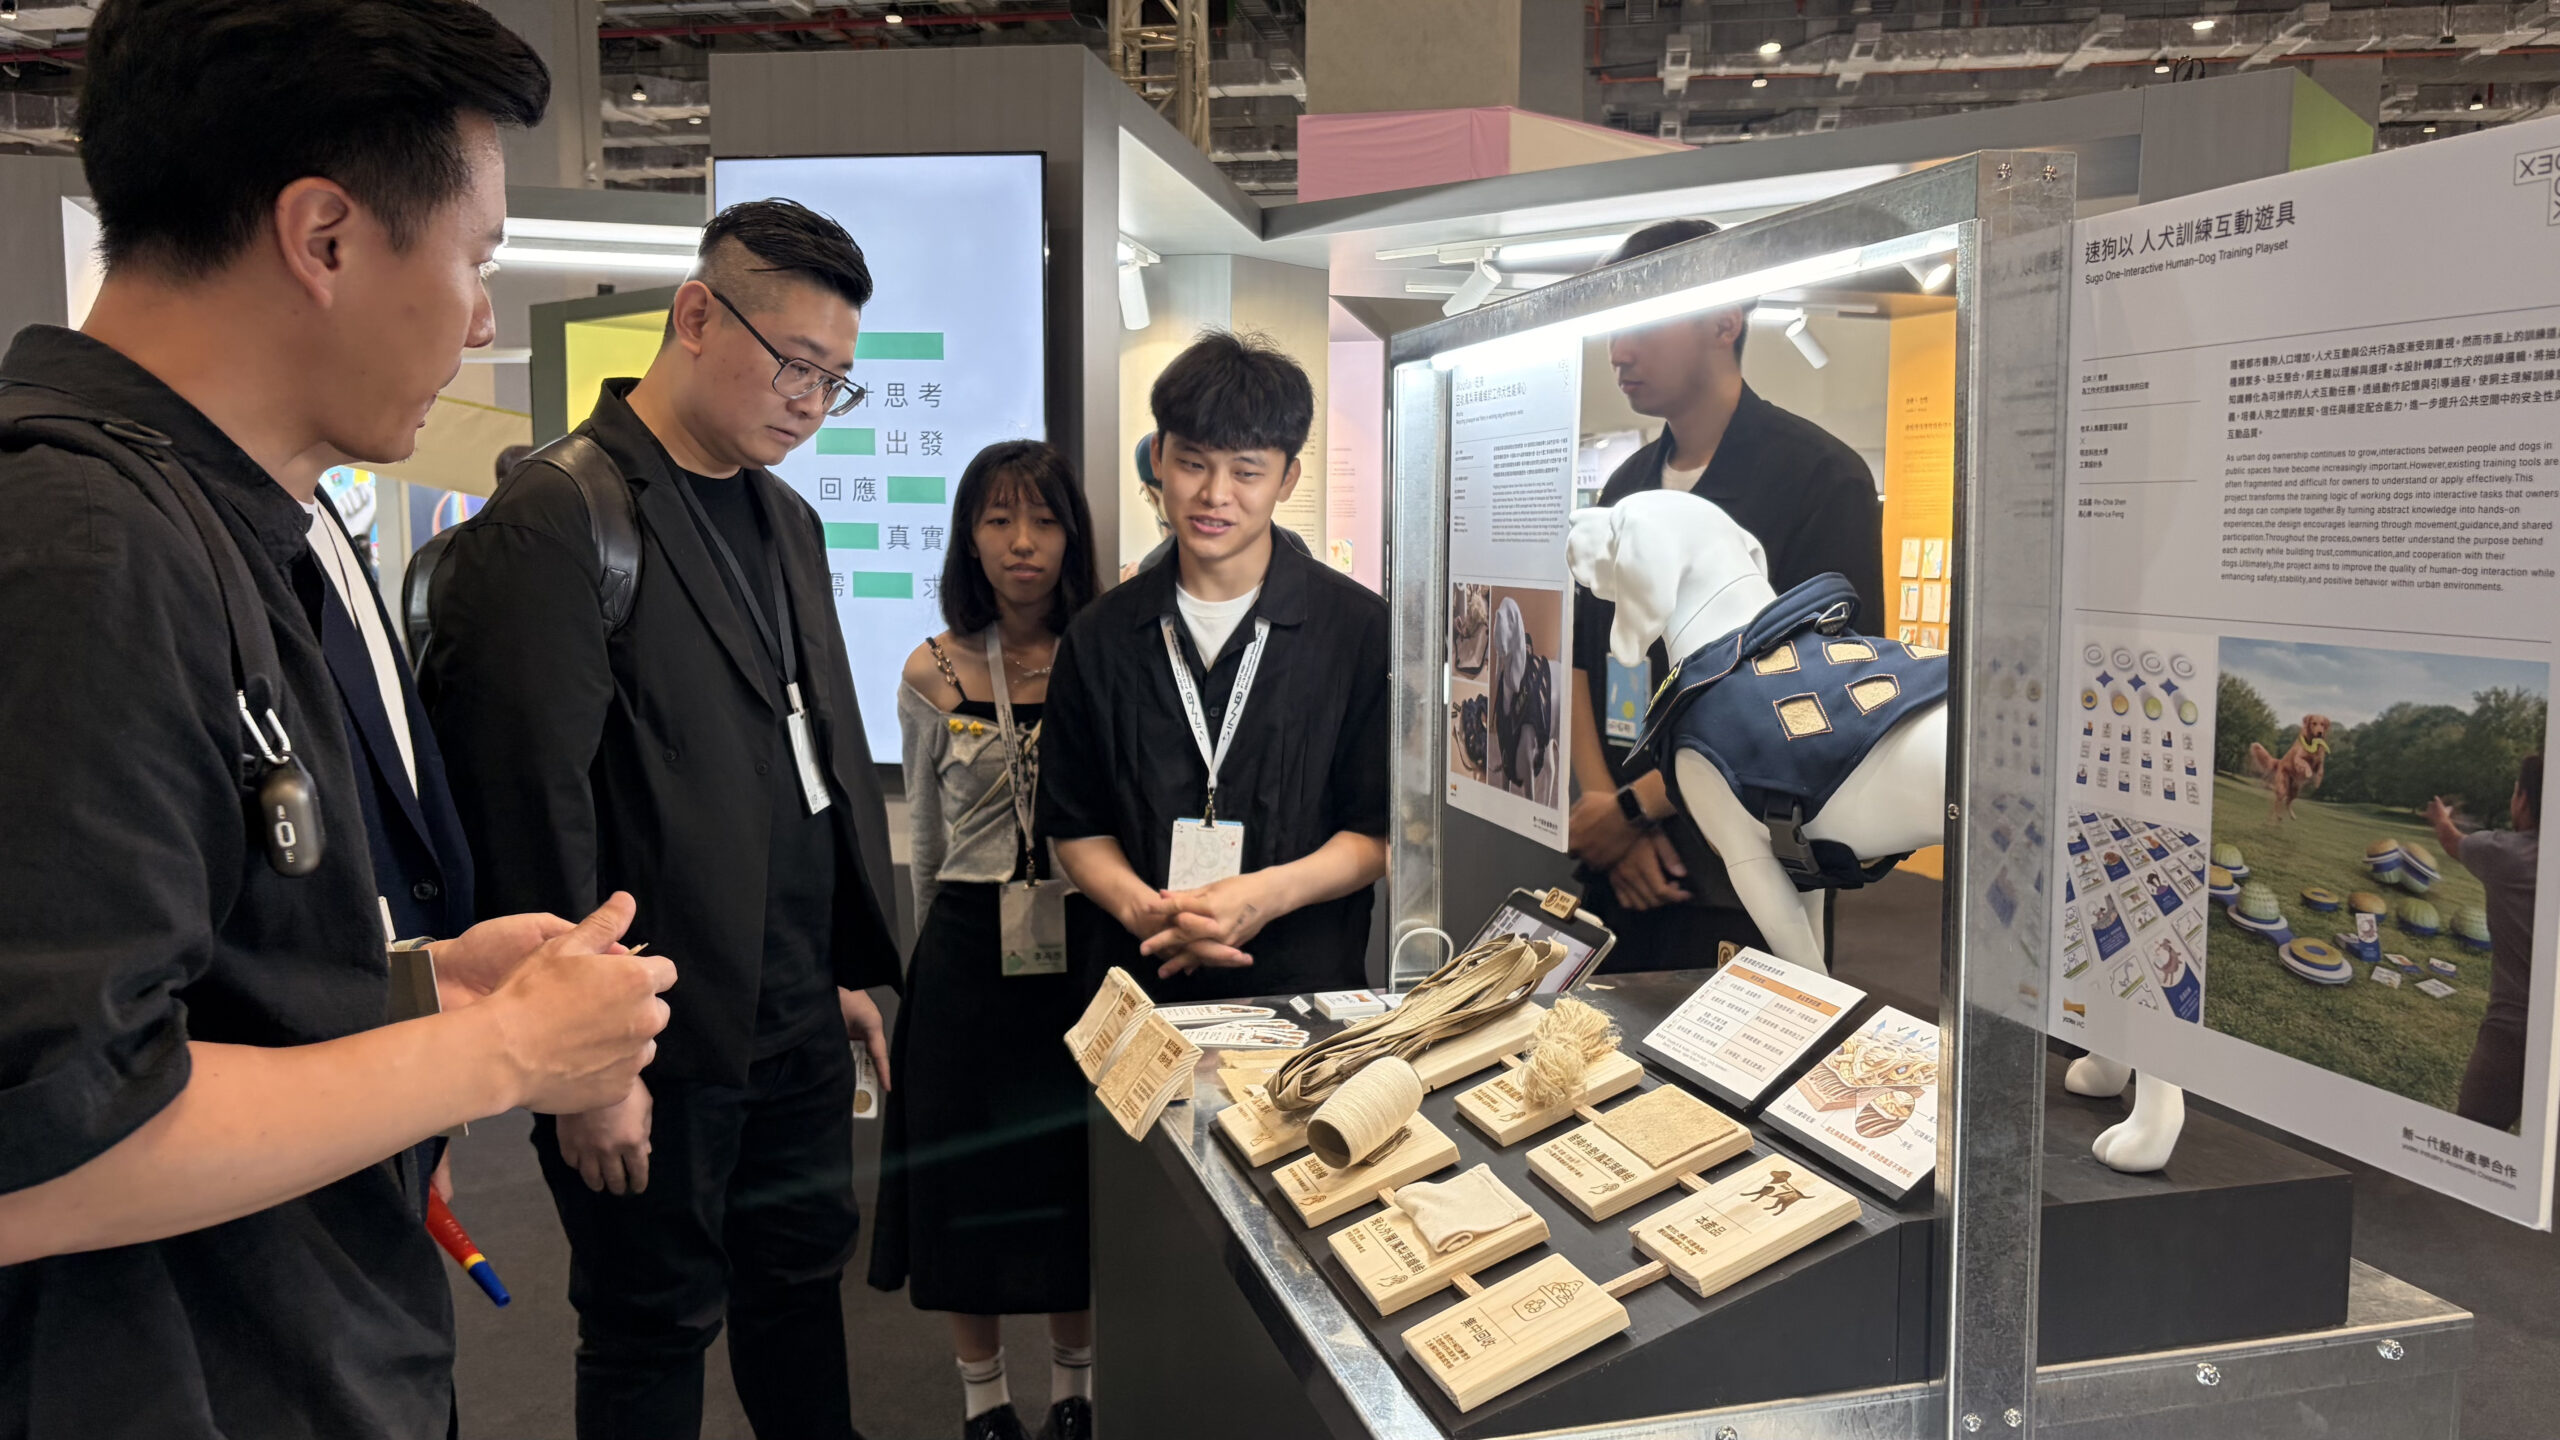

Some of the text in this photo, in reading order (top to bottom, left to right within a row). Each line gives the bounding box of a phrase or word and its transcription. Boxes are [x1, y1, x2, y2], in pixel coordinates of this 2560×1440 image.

[2085, 201, 2295, 264] 速狗以 人犬訓練互動遊具
[2085, 274, 2103, 285] Sugo
[2219, 246, 2253, 260] Training
[2256, 240, 2288, 254] Playset
[886, 430, 943, 456] 出發
[2257, 453, 2270, 462] dog
[2428, 446, 2464, 454] between
[2466, 443, 2496, 453] people
[2500, 442, 2515, 451] and
[2519, 443, 2540, 452] dogs
[2544, 441, 2552, 450] in
[2322, 464, 2367, 473] increasingly
[2483, 459, 2516, 469] training
[2519, 458, 2541, 466] tools
[2544, 458, 2559, 466] are
[2284, 479, 2297, 487] and
[2300, 478, 2327, 486] difficult
[2330, 477, 2339, 486] for
[2342, 478, 2369, 486] owners
[2372, 477, 2379, 485] to
[2382, 476, 2426, 485] understand
[2441, 476, 2463, 485] apply
[819, 477, 877, 502] 回應
[2225, 494, 2247, 502] project
[2301, 493, 2327, 502] training
[2330, 492, 2348, 501] logic
[2351, 492, 2358, 500] of
[2361, 492, 2390, 501] working
[2393, 492, 2413, 501] dogs
[2416, 491, 2430, 499] into
[2433, 491, 2477, 499] interactive
[2480, 490, 2502, 498] tasks
[2506, 490, 2522, 498] that
[2526, 490, 2559, 498] owners
[2238, 507, 2253, 516] dogs
[2348, 507, 2374, 516] turning
[2377, 506, 2409, 514] abstract
[2412, 506, 2456, 516] knowledge
[2459, 505, 2475, 514] into
[2278, 521, 2301, 530] design
[2303, 521, 2345, 530] encourages
[2348, 521, 2378, 530] learning
[2381, 521, 2411, 530] through
[2522, 521, 2552, 530] shared
[887, 525, 944, 550] 真實
[2409, 536, 2454, 544] understand
[2457, 536, 2470, 544] the
[2474, 537, 2509, 546] purpose
[2512, 537, 2543, 545] behind
[2286, 548, 2313, 558] building
[2413, 552, 2461, 560] cooperation
[2465, 551, 2482, 560] with
[2486, 552, 2505, 560] their
[2287, 562, 2311, 570] project
[2375, 564, 2386, 572] the
[2390, 565, 2415, 574] quality
[2419, 565, 2426, 573] of
[2481, 568, 2527, 576] interaction
[2531, 569, 2555, 577] while
[2324, 577, 2352, 585] positive
[2355, 578, 2387, 586] behavior
[1695, 1215, 1727, 1237] 本產品
[1460, 1317, 1496, 1350] 集中回收
